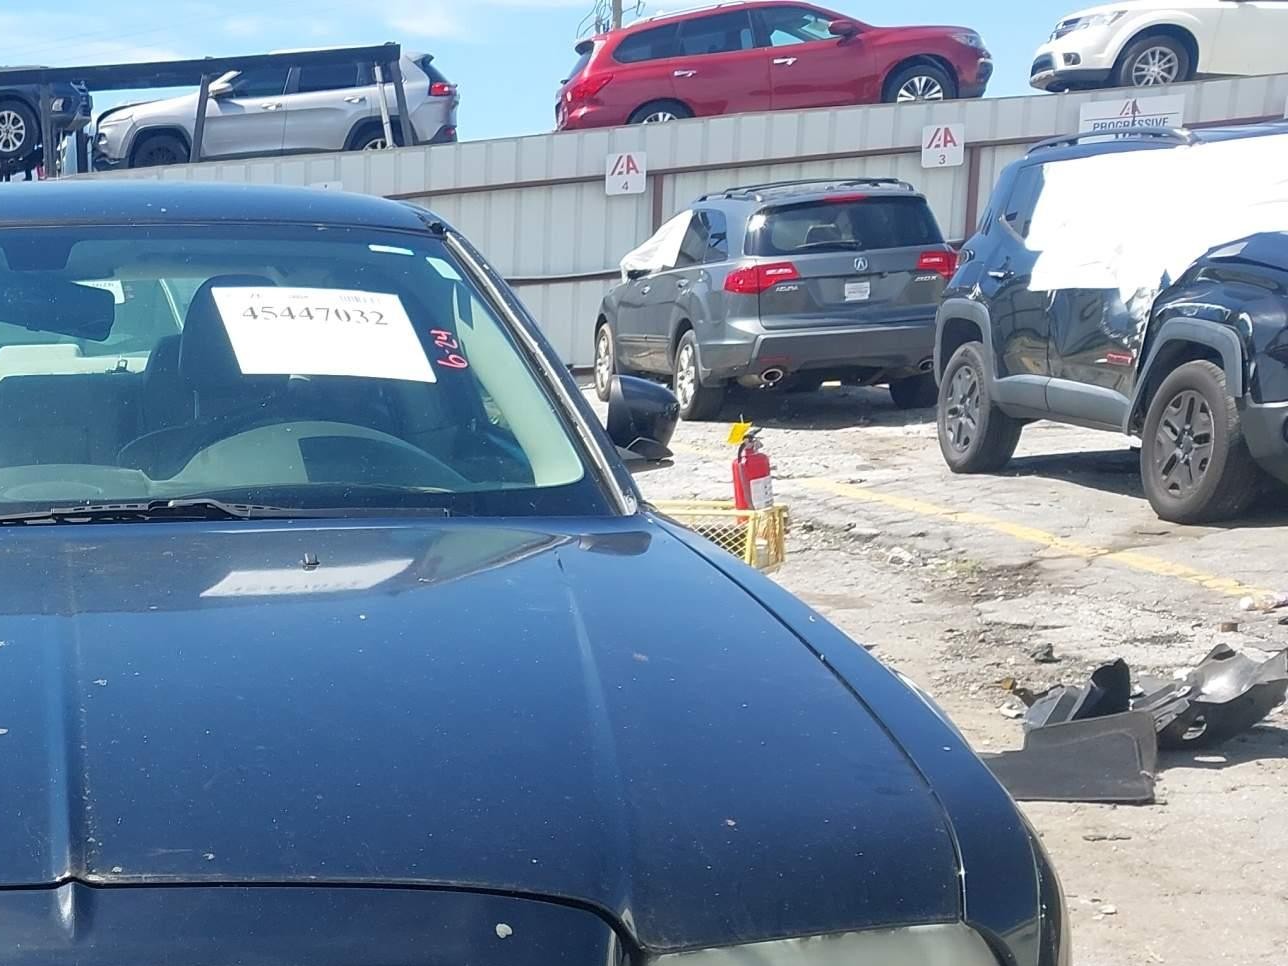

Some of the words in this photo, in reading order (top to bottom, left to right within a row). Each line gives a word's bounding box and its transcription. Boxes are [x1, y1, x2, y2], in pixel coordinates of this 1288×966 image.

[939, 154, 946, 164] 3
[621, 181, 629, 191] 4
[242, 306, 389, 326] 45447032
[430, 329, 468, 368] 6-24
